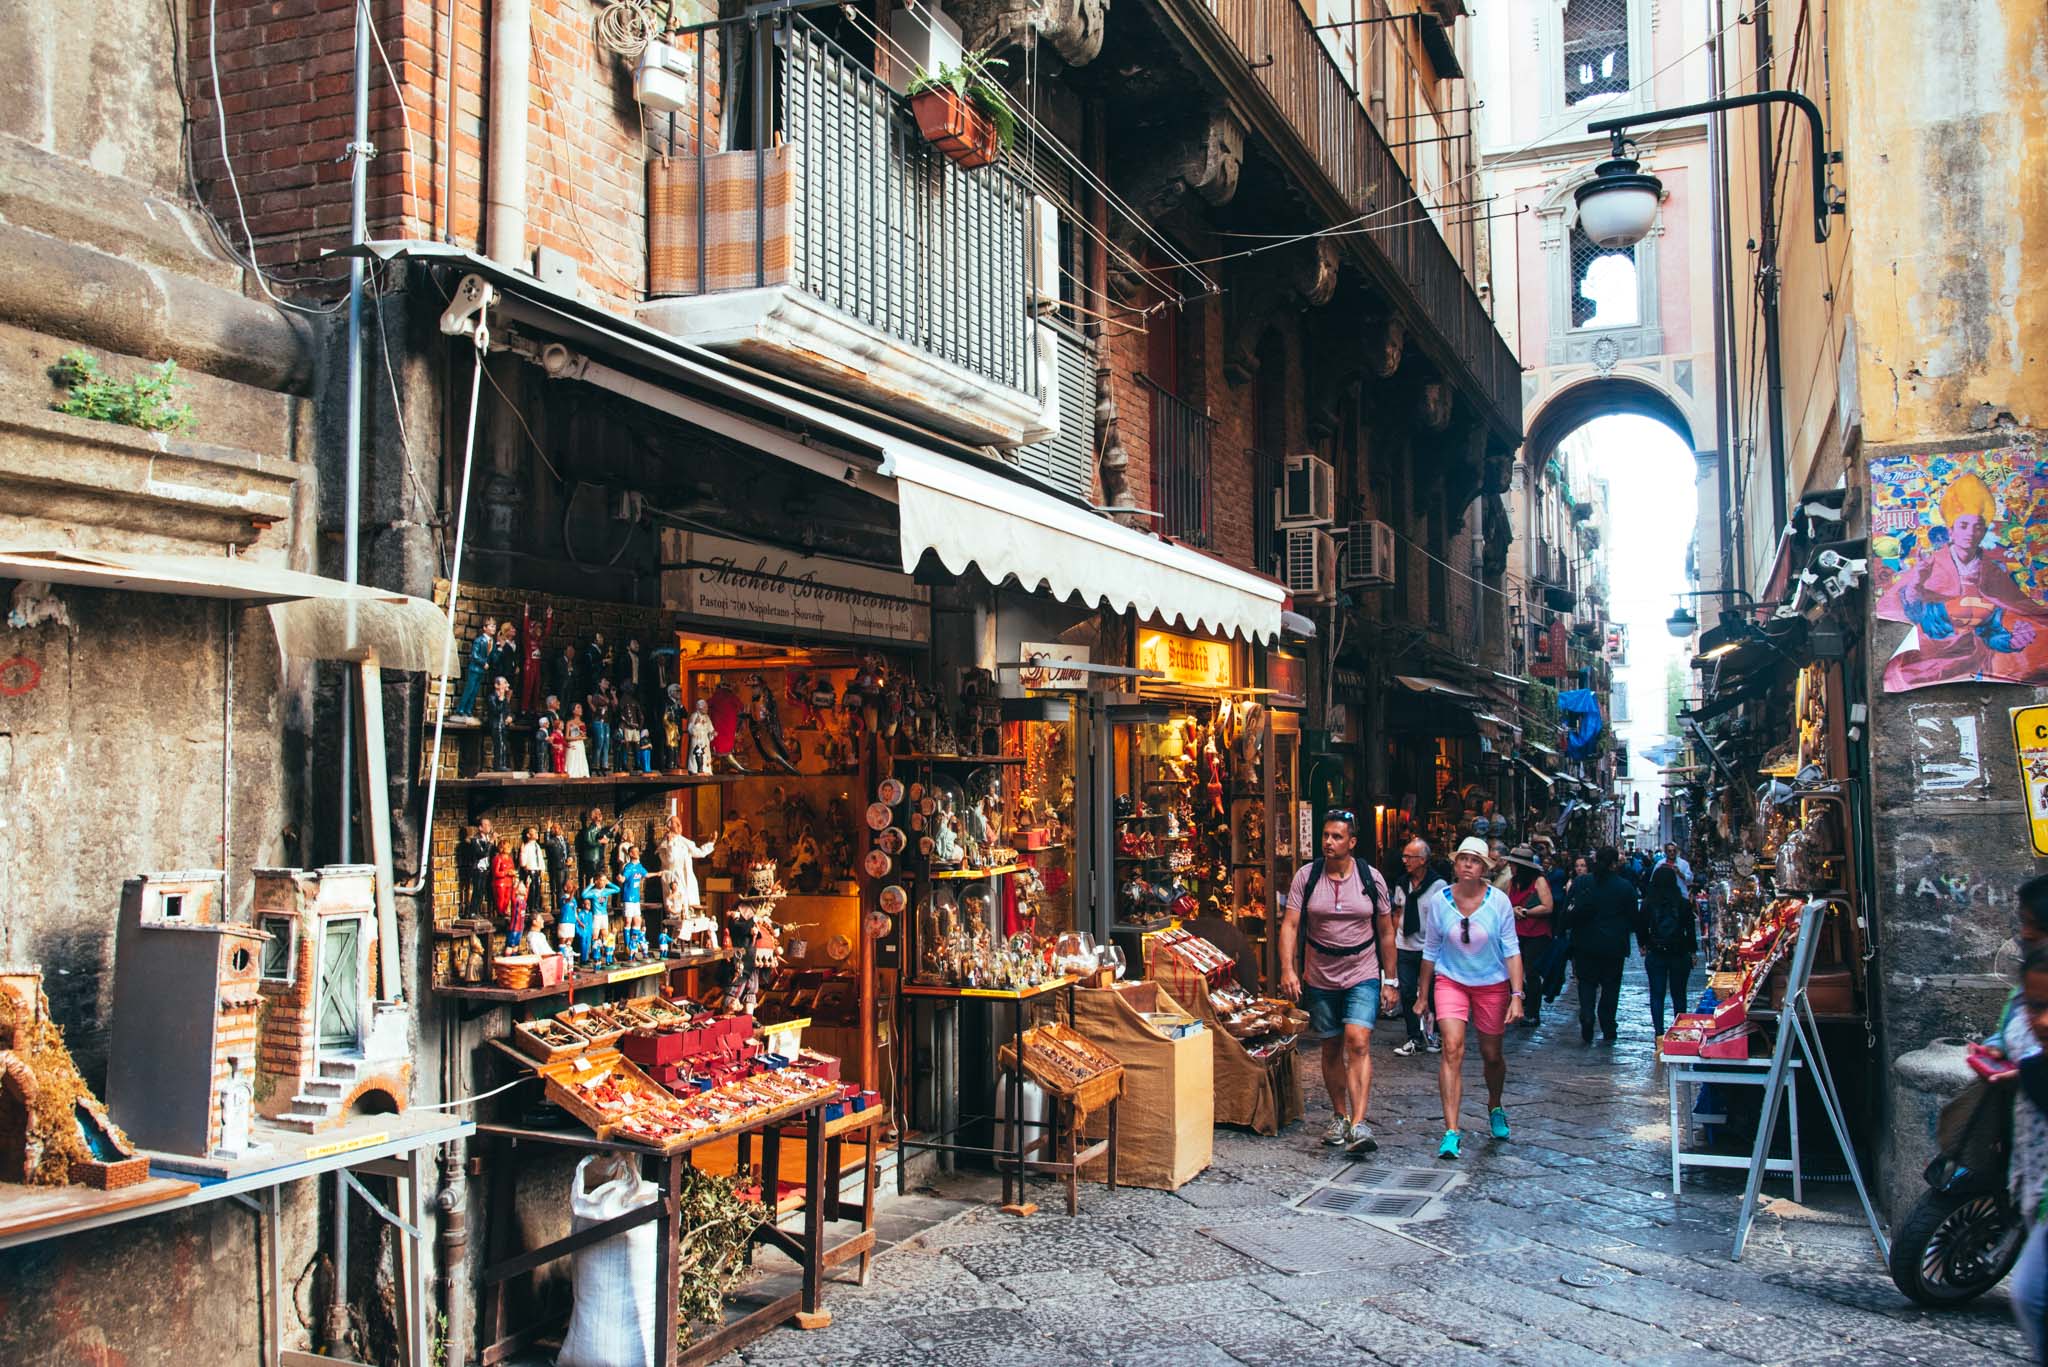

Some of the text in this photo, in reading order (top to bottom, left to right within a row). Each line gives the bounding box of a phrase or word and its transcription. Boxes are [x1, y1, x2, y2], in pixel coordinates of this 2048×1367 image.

[699, 556, 909, 613] Michele Buonincontro
[700, 594, 729, 610] Pastori
[748, 601, 790, 618] Napoletano
